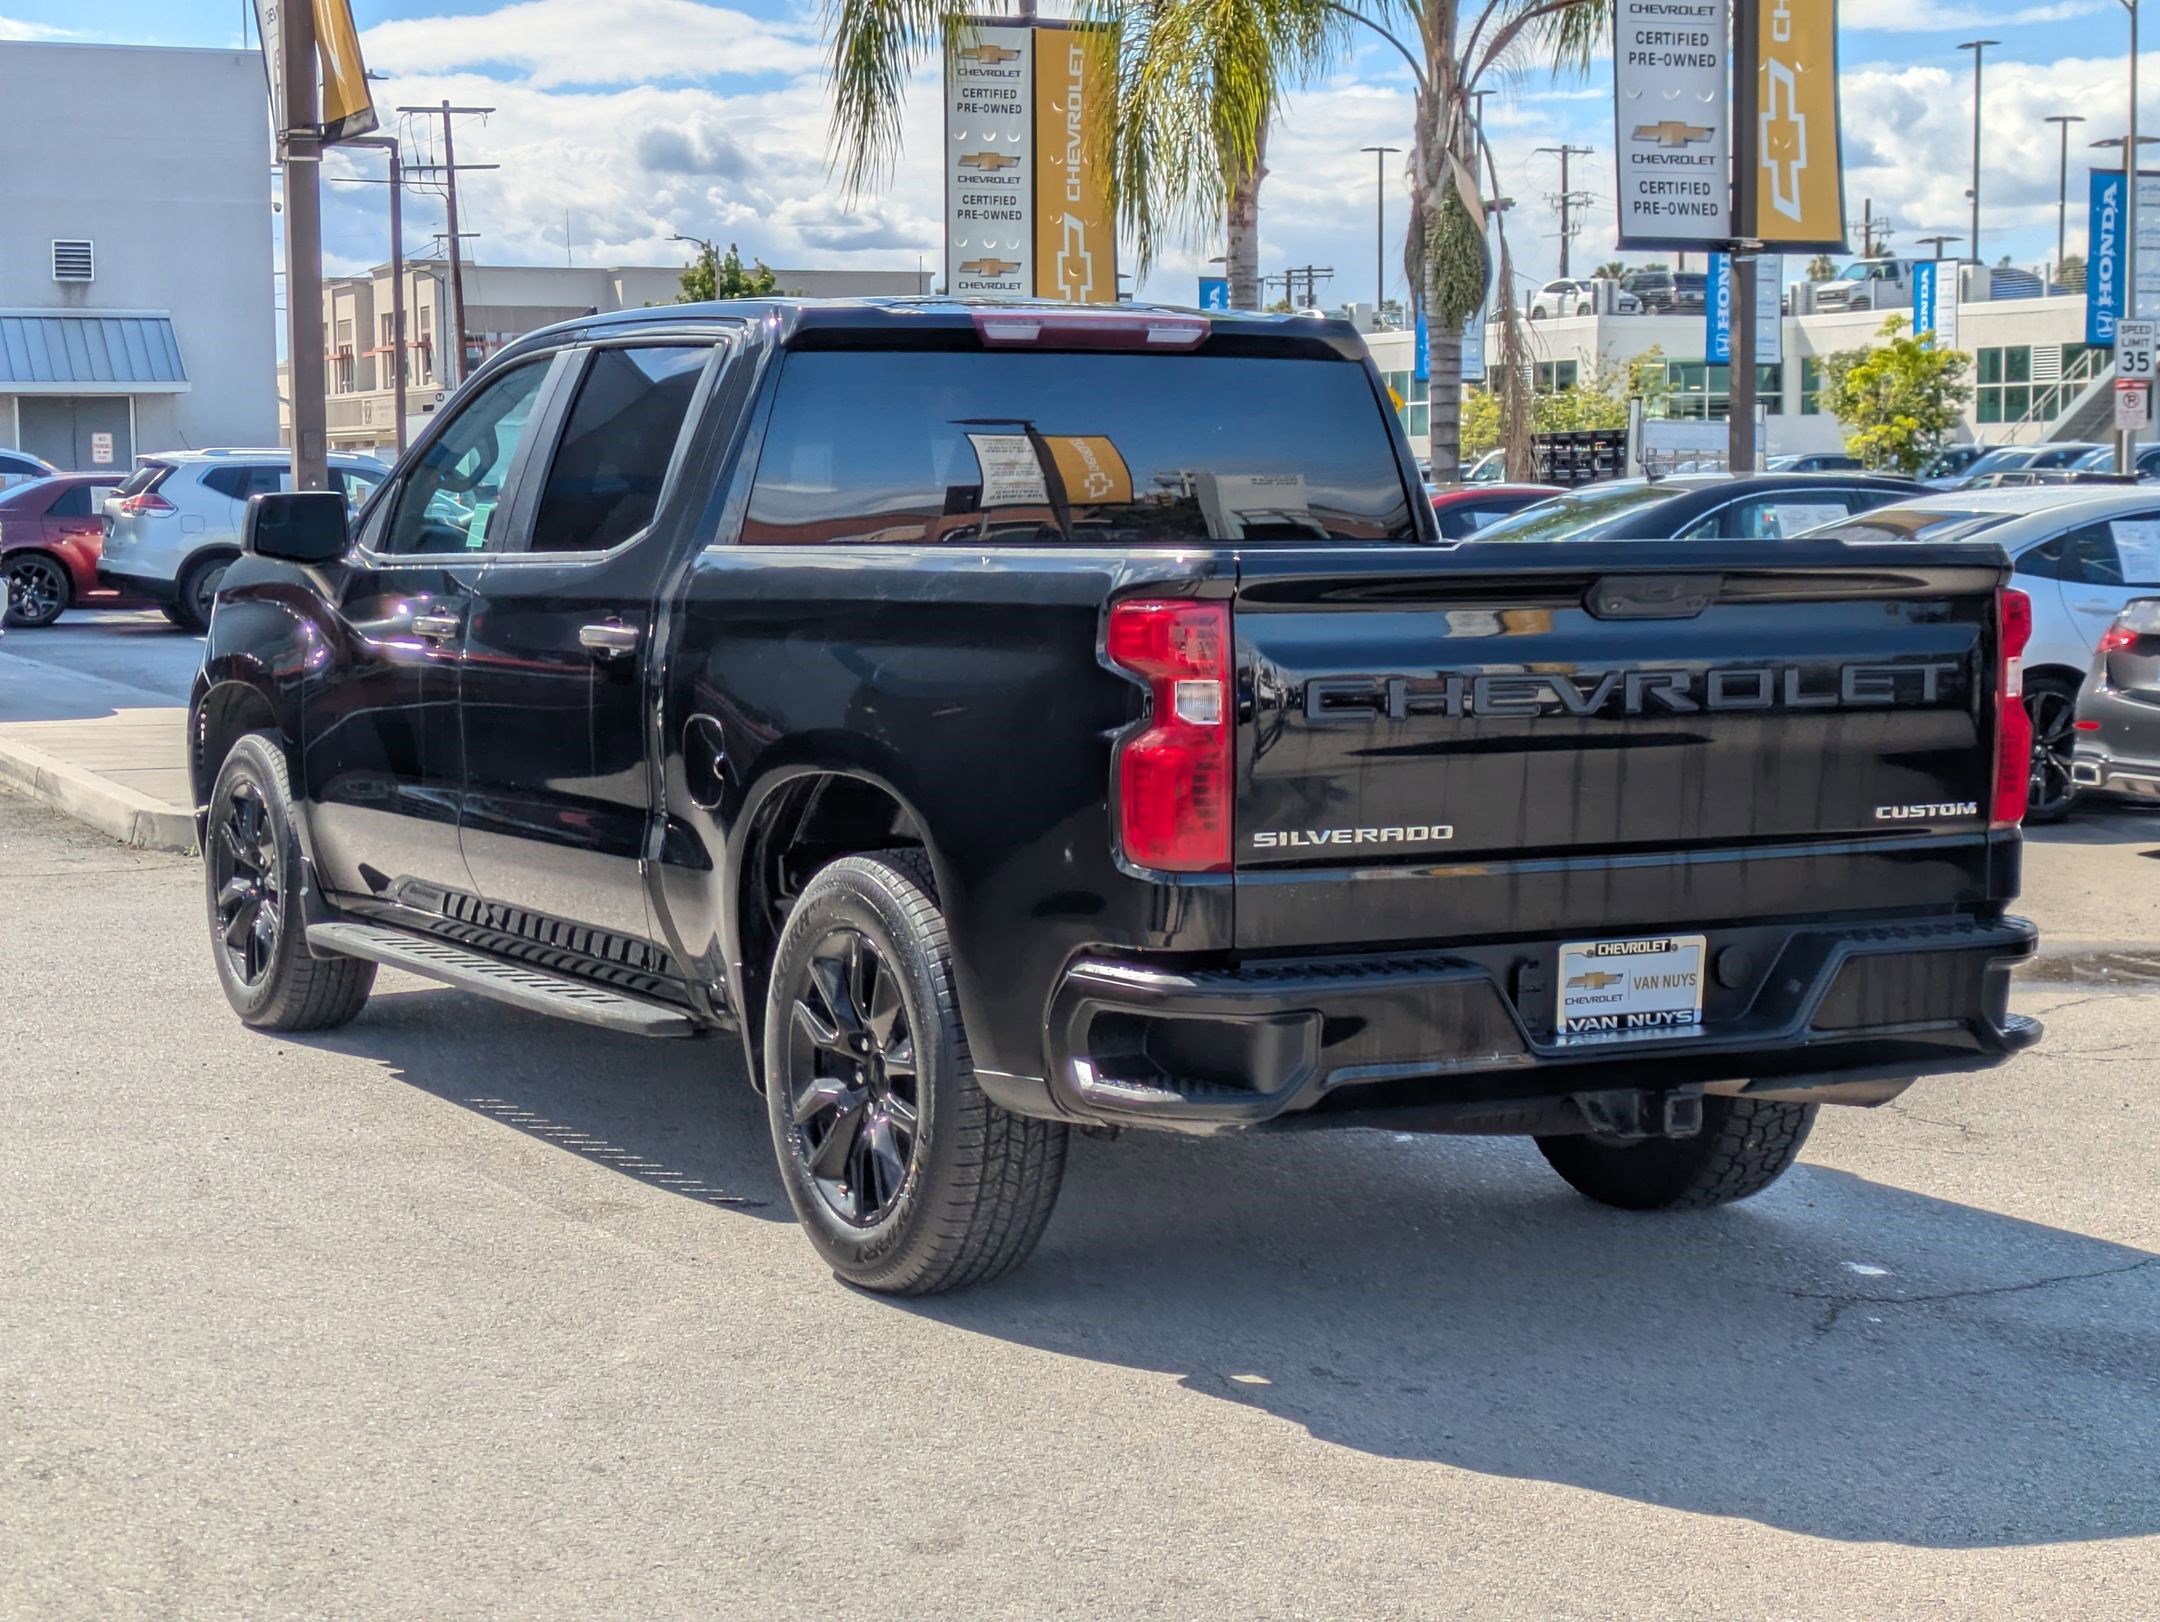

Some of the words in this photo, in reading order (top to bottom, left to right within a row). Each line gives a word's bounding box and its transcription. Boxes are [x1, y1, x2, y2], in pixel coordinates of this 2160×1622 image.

[1630, 3, 1716, 16] CHEVROLET
[1635, 31, 1709, 46] CERTIFIED
[1628, 52, 1716, 68] PRE-OWNED
[957, 68, 1021, 78] CHEVROLET
[962, 87, 1017, 99] CERTIFIED
[957, 102, 1022, 114] PRE-OWNED
[1066, 44, 1084, 201] CHEVROLET
[1631, 153, 1716, 166] CHEVROLET
[957, 175, 1021, 185] CHEVROLET
[1639, 180, 1711, 196] CERTIFIED
[962, 194, 1017, 206] CERTIFIED
[957, 209, 1022, 221] PRE-OWNED
[1633, 201, 1718, 217] PRE-OWNED
[2098, 181, 2118, 308] HONDA
[958, 281, 1022, 290] CHEVROLET
[1920, 267, 1930, 341] ONDA
[2121, 325, 2151, 335] SPEED
[2121, 338, 2150, 347] LIMIT
[2122, 351, 2149, 372] 35
[1302, 662, 1960, 720] CHEVROLET
[1875, 802, 1978, 820] CUSTOM
[1253, 825, 1454, 849] SILVERADO
[1597, 940, 1669, 956] CHEVROLET
[1633, 976, 1659, 991] VAN
[1663, 973, 1697, 988] NUYS
[1565, 994, 1623, 1006] CHEVROLET
[1568, 1016, 1618, 1032] VAN
[1627, 1010, 1693, 1027] NUYS
